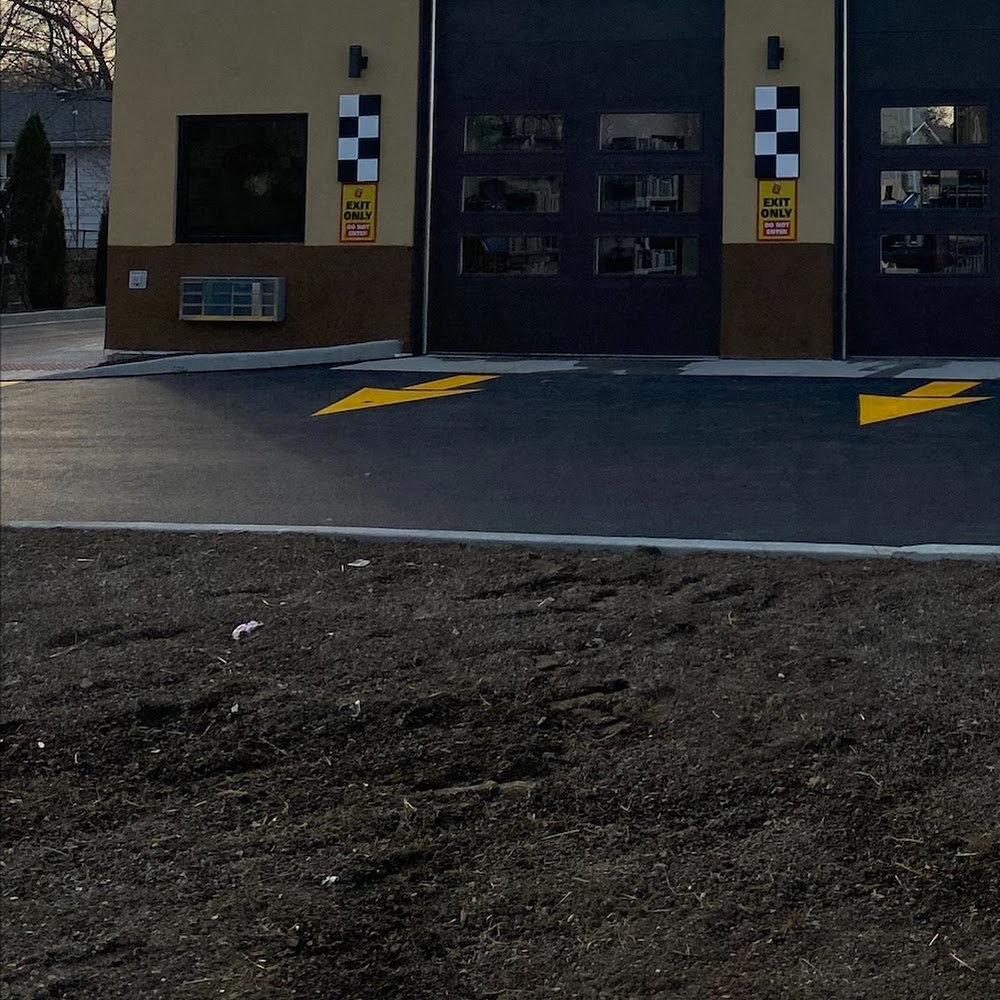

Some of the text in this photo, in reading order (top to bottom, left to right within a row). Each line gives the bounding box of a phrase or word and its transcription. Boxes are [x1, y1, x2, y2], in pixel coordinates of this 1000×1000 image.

[346, 201, 371, 210] EXIT
[763, 198, 791, 207] EXIT
[344, 211, 372, 220] ONLY
[761, 209, 792, 218] ONLY
